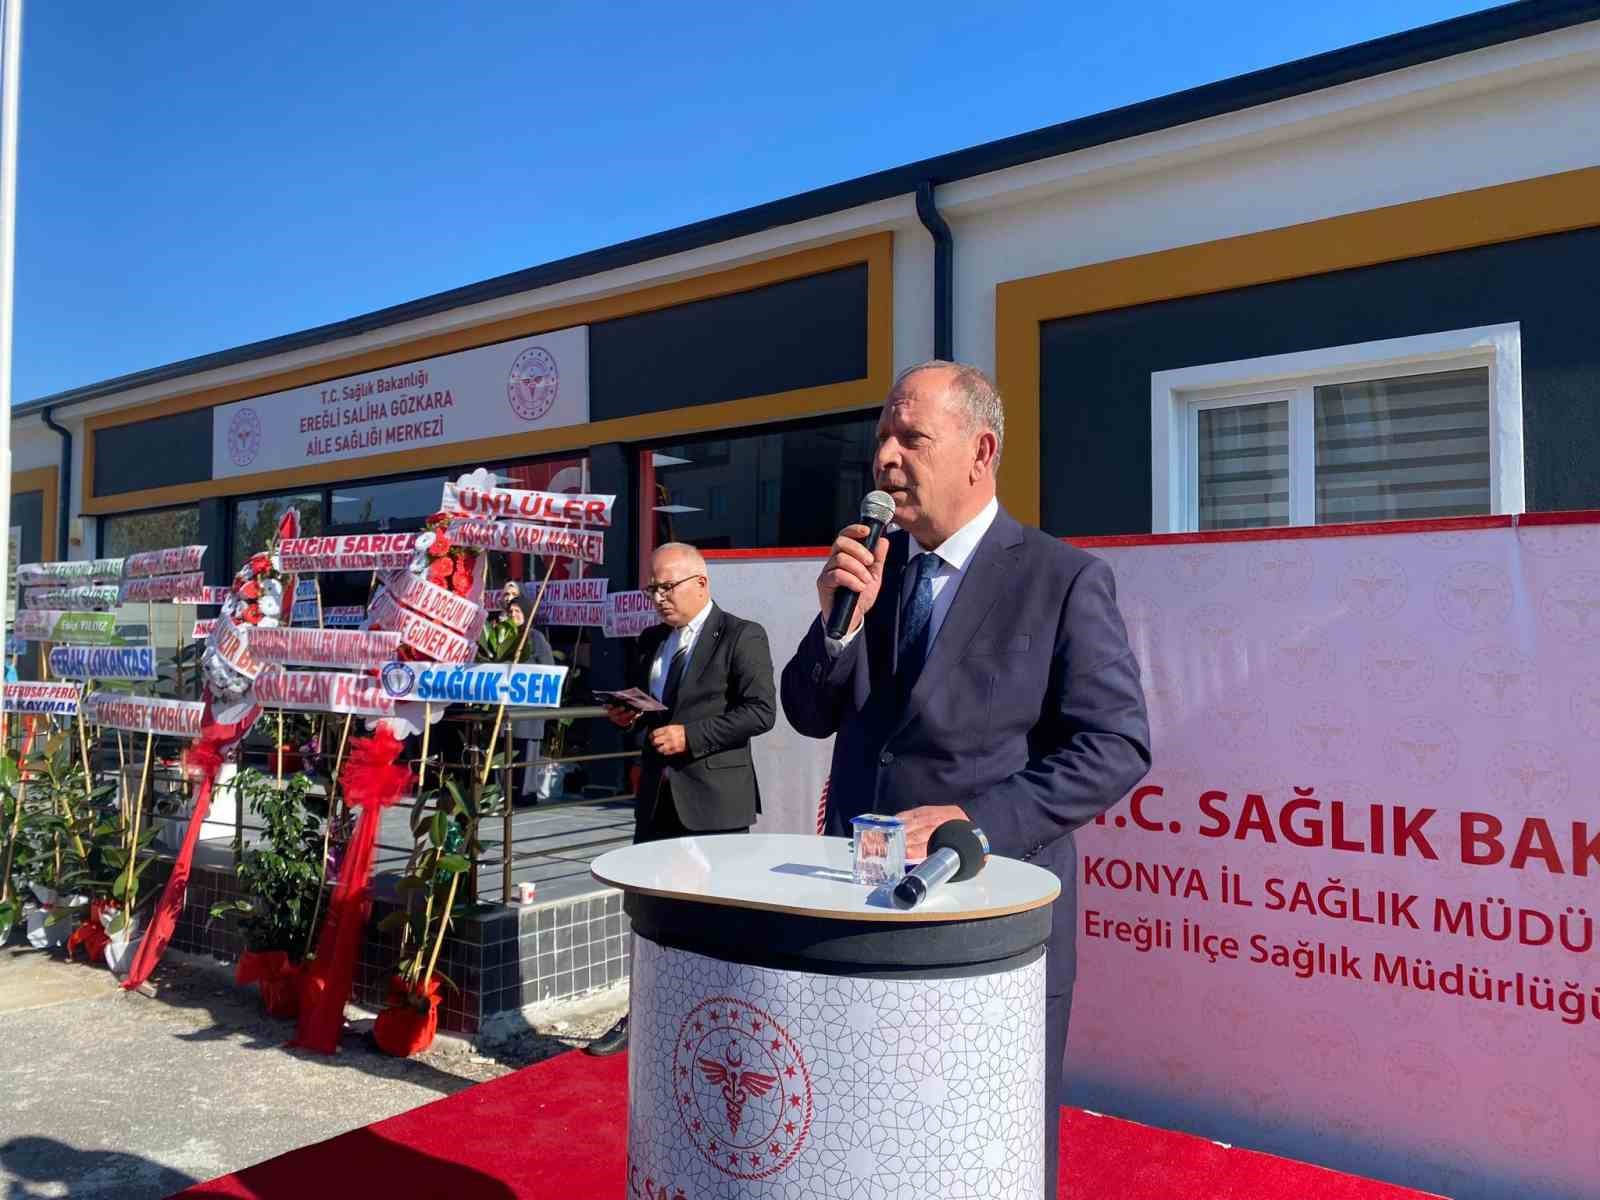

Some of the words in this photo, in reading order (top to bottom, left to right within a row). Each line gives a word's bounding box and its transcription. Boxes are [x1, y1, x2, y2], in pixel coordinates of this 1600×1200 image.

[321, 390, 340, 404] T.C.
[343, 383, 374, 401] Sağlık
[377, 370, 428, 394] Bakanlığı
[300, 407, 340, 433] EREĞLİ
[343, 401, 388, 425] SALİHA
[391, 390, 453, 417] GÖZKARA
[306, 434, 332, 456] AİLE
[335, 430, 382, 452] SAĞLIĞI
[386, 414, 444, 445] MERKEZİ
[459, 487, 610, 524] ÜNLÜLER
[546, 531, 604, 562] MARKET
[255, 672, 332, 705] RAMAZAN
[418, 665, 561, 705] SAĞLIK-SEN
[152, 703, 201, 733] MOBİLYA
[1095, 785, 1181, 834] .C.
[1199, 786, 1439, 861] SAĞLIK
[1084, 855, 1208, 901] KONYA
[1221, 865, 1252, 907] İL
[1265, 877, 1421, 930] SAĞLIK
[1433, 897, 1593, 953] MÜDÜ
[1085, 910, 1171, 952] Ereğli
[1183, 918, 1239, 963] İlçe
[1250, 934, 1362, 979] Sağlık
